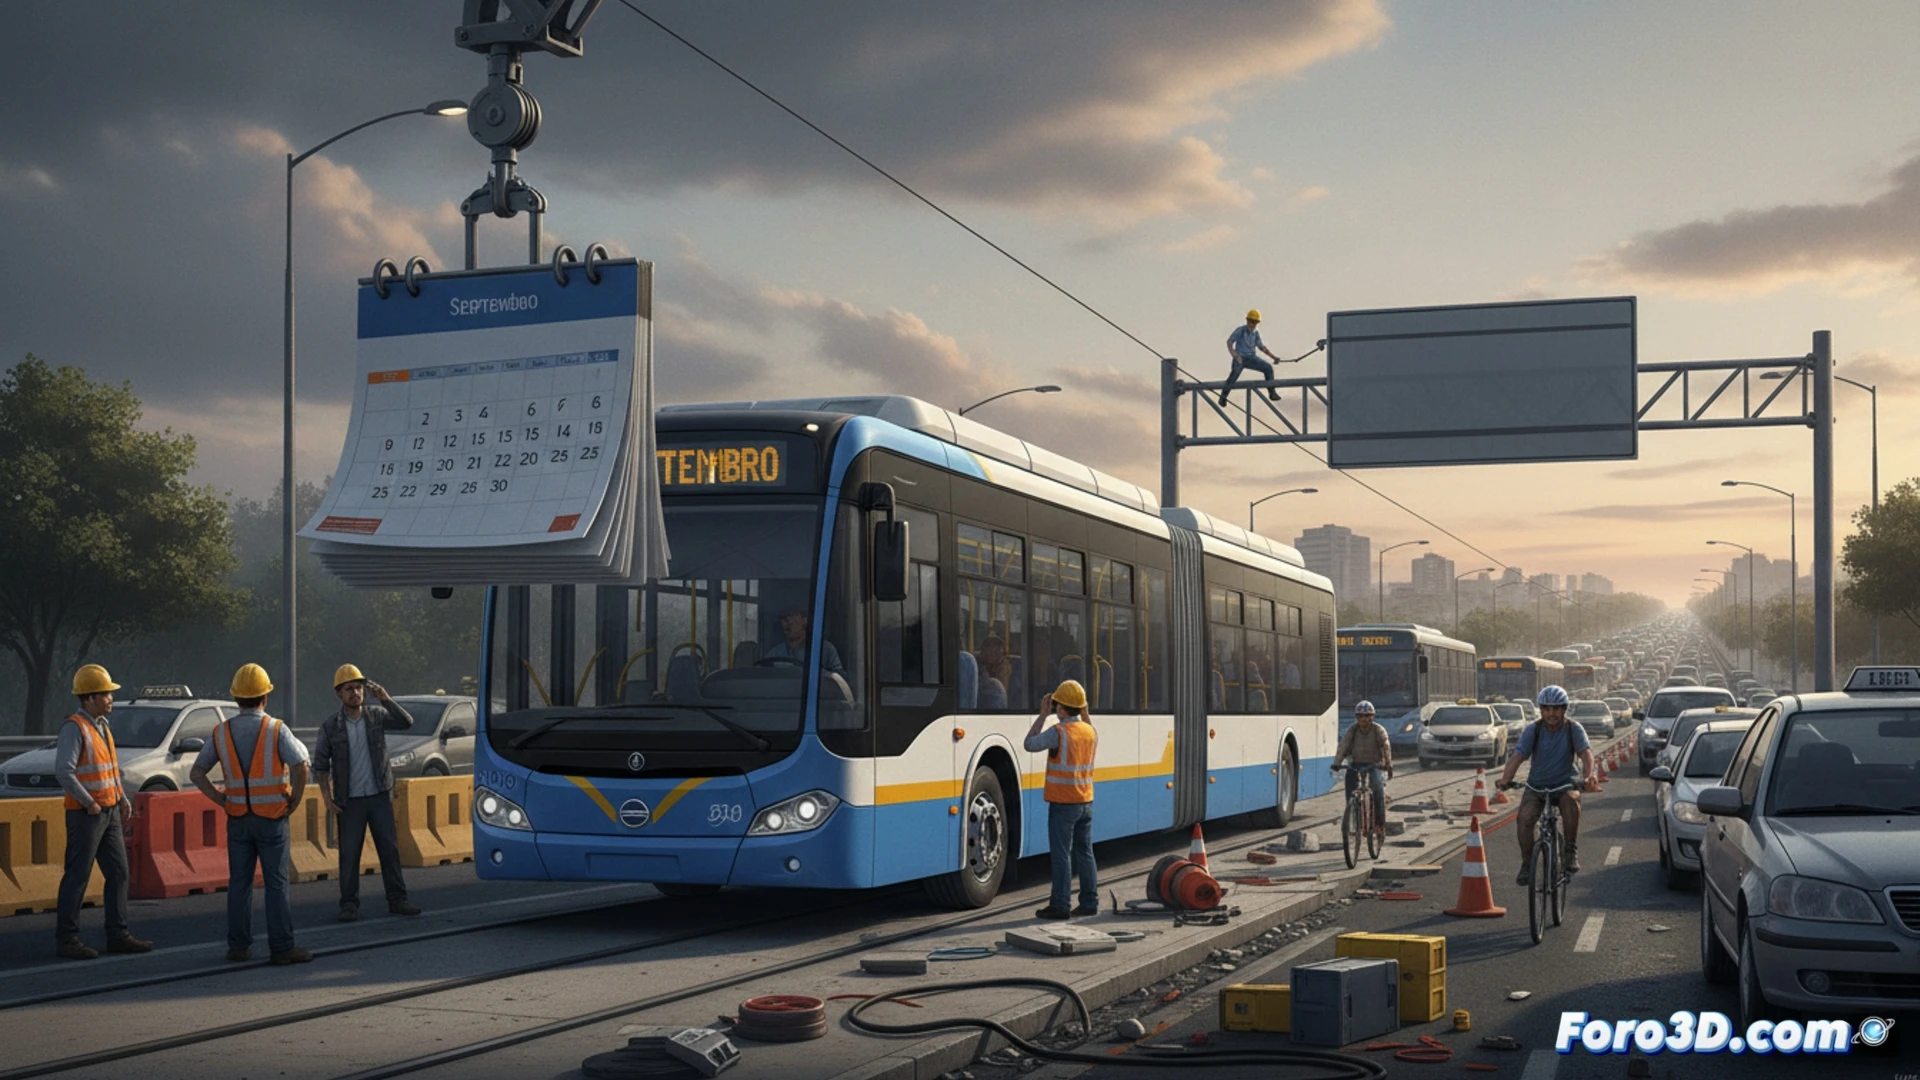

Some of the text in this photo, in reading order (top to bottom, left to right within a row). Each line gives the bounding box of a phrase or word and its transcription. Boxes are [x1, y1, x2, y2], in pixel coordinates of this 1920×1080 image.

[421, 412, 430, 426] 2
[454, 409, 463, 422] 3
[527, 402, 536, 416] 6
[591, 395, 601, 409] 6
[443, 434, 457, 448] 12
[472, 432, 486, 445] 15
[498, 429, 513, 443] 15
[525, 427, 540, 441] 15
[557, 424, 571, 438] 14
[408, 461, 424, 474] 19
[467, 456, 482, 470] 21
[519, 452, 538, 466] 20
[550, 449, 568, 463] 25
[580, 446, 599, 460] 25
[371, 486, 389, 499] 25
[400, 485, 417, 498] 22
[429, 483, 448, 496] 29
[489, 479, 508, 493] 30
